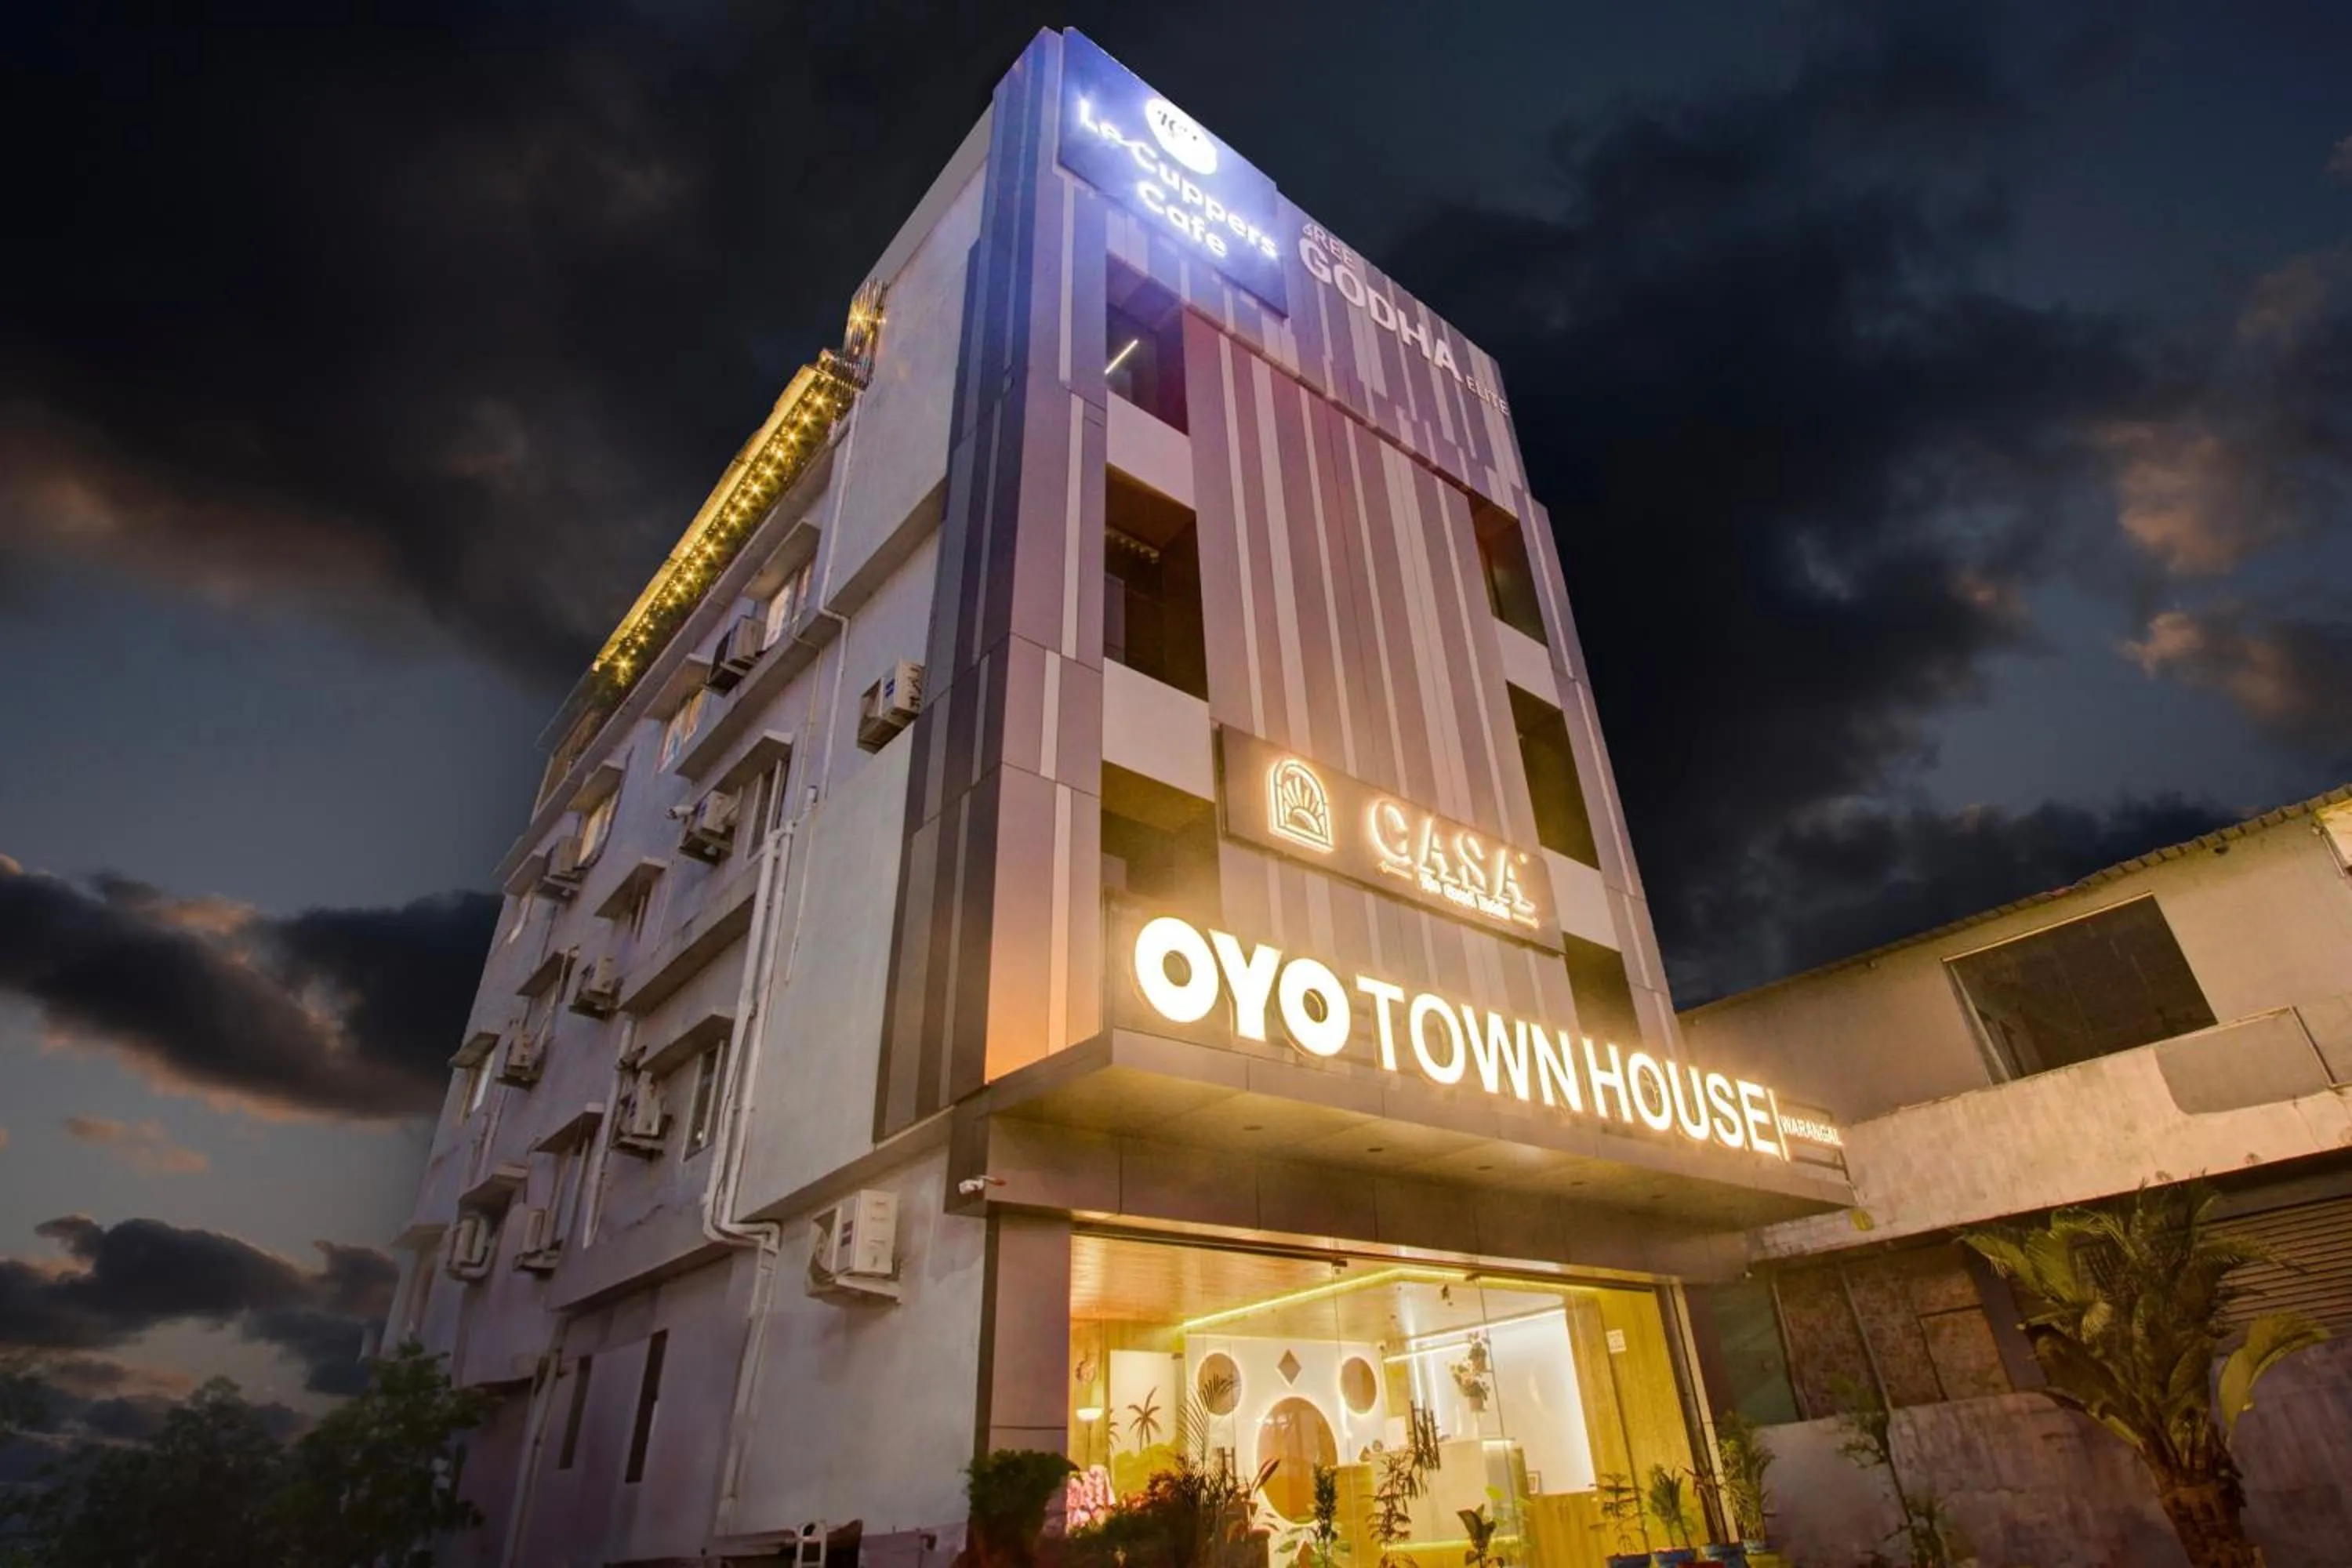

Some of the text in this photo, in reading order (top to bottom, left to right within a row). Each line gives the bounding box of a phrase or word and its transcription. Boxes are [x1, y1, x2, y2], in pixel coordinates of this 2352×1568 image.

[1137, 181, 1228, 258] Cafe
[1302, 223, 1358, 270] SREE
[1299, 237, 1465, 383] GODHA
[1465, 374, 1510, 415] ELITE
[1134, 916, 1351, 1057] OYO
